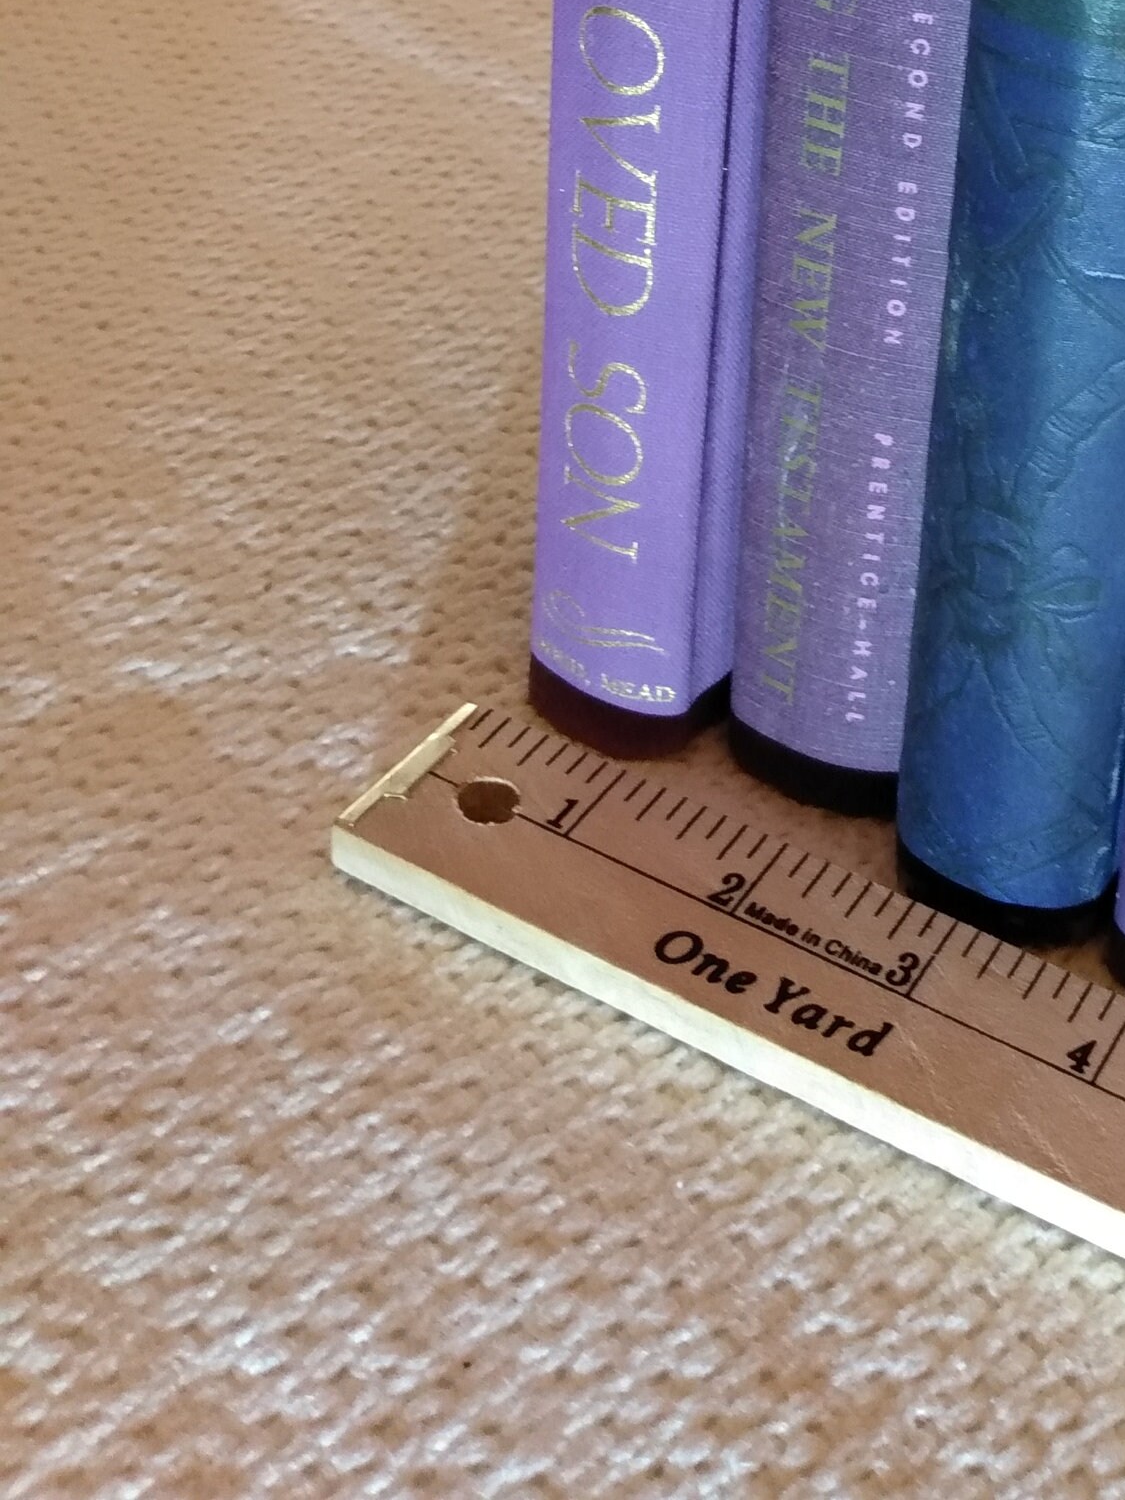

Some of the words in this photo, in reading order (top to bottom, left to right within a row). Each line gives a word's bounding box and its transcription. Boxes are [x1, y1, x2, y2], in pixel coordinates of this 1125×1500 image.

[799, 50, 851, 177] THE
[788, 197, 838, 352] NEW
[883, 181, 919, 345] EDITION
[560, 340, 648, 564] SON
[845, 432, 895, 722] PRENTICE-HALL
[545, 798, 580, 831] 1
[707, 872, 747, 906] 2
[885, 952, 920, 987] 3
[1067, 1039, 1099, 1075] 4
[654, 930, 758, 994] One
[763, 976, 895, 1057] Yard
[743, 901, 800, 937] Made
[802, 927, 822, 947] in
[824, 938, 883, 976] China
